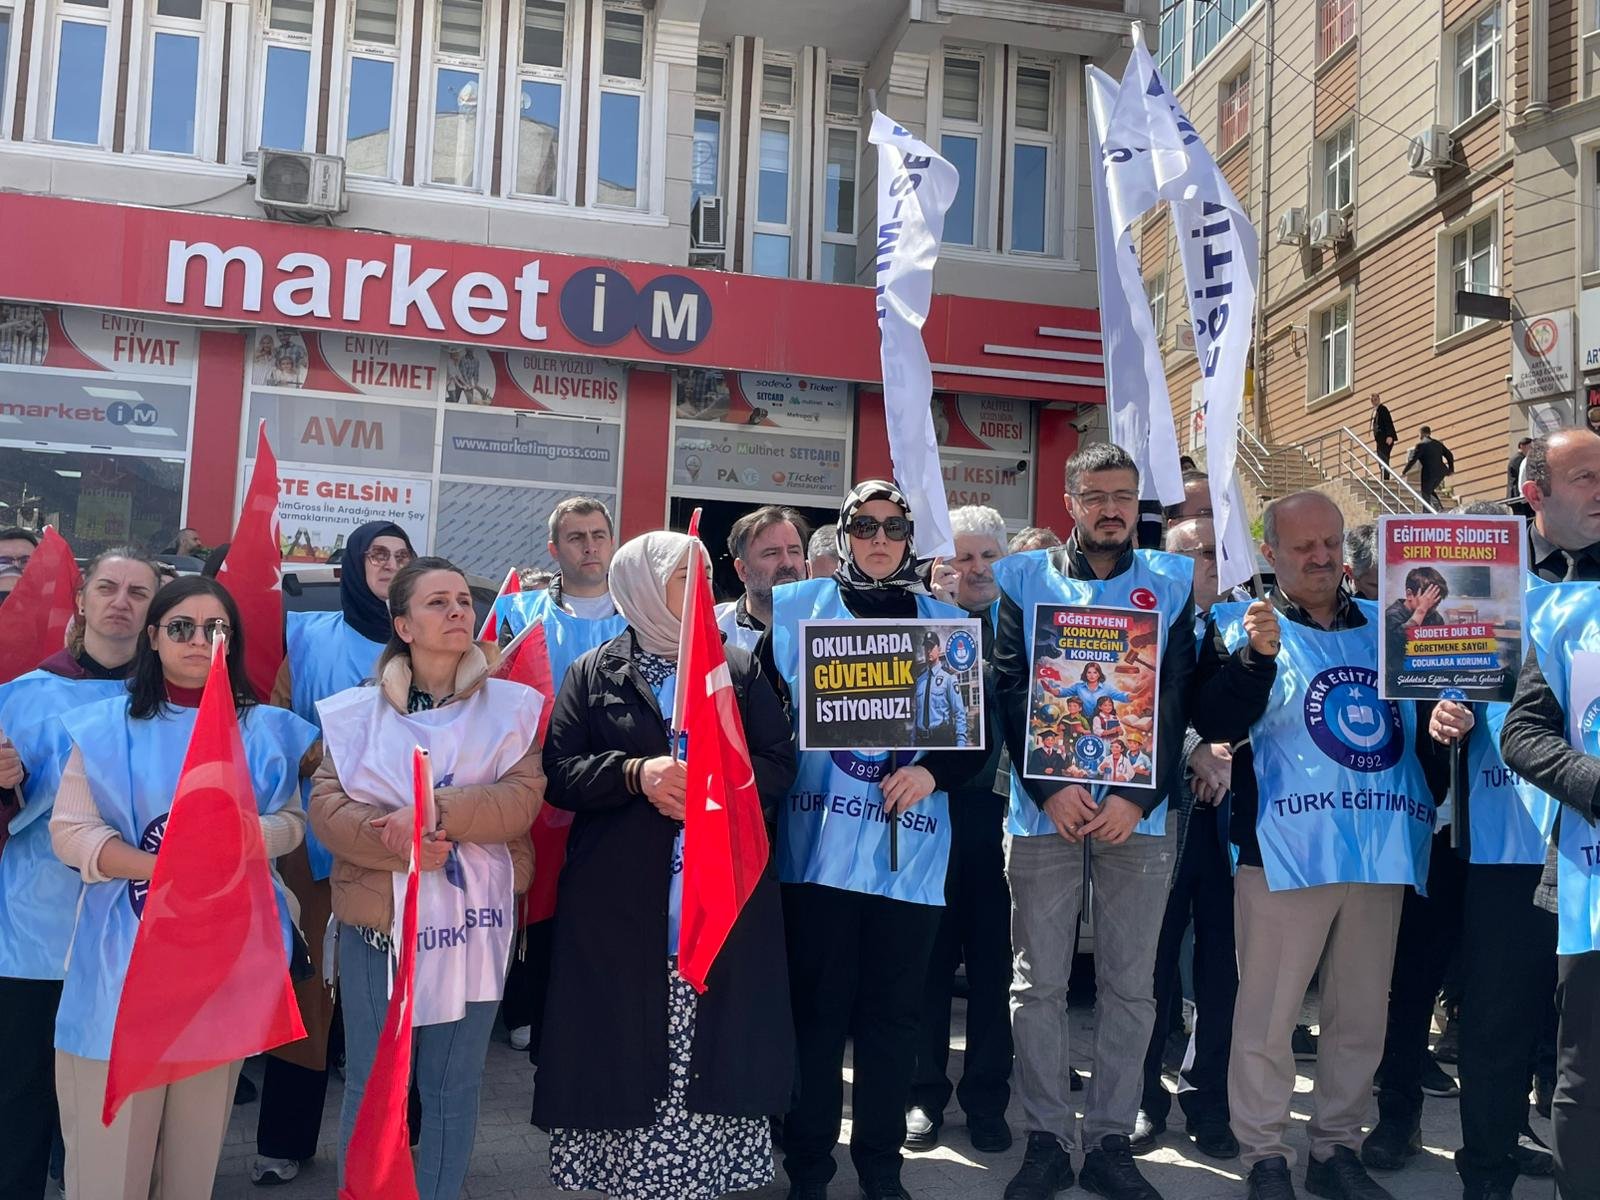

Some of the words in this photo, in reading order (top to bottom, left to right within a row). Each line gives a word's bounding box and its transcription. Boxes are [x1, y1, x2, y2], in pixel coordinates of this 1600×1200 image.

[164, 238, 549, 341] market
[101, 313, 121, 330] EN
[113, 332, 180, 366] FİYAT
[345, 336, 365, 354] EN
[1586, 347, 1600, 365] AR
[351, 357, 437, 390] HİZMET
[532, 374, 619, 404] ALIŞVERİŞ
[0, 403, 106, 422] market
[300, 416, 384, 450] AVM
[979, 421, 1023, 440] ADRESİ
[454, 436, 610, 461] www.marketimgross.com
[737, 441, 785, 457] Multinet
[790, 447, 840, 462] SETCARD
[787, 471, 826, 484] Ticket
[964, 466, 1017, 486] KESİM
[316, 481, 398, 503] GELSİN
[388, 509, 405, 518] Her
[1393, 525, 1452, 543] EĞİTİMDE
[1455, 526, 1509, 545] ŞİDDETE
[1403, 546, 1432, 559] SIFIR
[1435, 547, 1497, 560] TOLERANS!
[1058, 611, 1128, 628] ÖĞRETMENİ
[1063, 627, 1119, 640] KORUYAN
[1414, 627, 1448, 639] ŞİDDETE
[1451, 627, 1469, 637] DUR
[1471, 626, 1486, 636] DE!
[812, 633, 913, 659] OKULLARDA
[1058, 637, 1124, 651] GELECEĞİNİ
[1413, 642, 1460, 653] ÖĞRETMENE
[1462, 642, 1488, 652] SAYGI!
[1070, 650, 1114, 662] KORUR.
[1411, 659, 1455, 669] ÇOCUKLARA
[1456, 658, 1491, 667] KORUMA!
[814, 656, 914, 690] GÜVENLİK
[816, 696, 911, 723] İSTİYORUZ!
[1307, 680, 1330, 725] TÜRK
[850, 761, 880, 778] 1992
[1349, 754, 1382, 768] 1992
[791, 792, 827, 812] TÜRK
[1275, 791, 1337, 817] TÜRK
